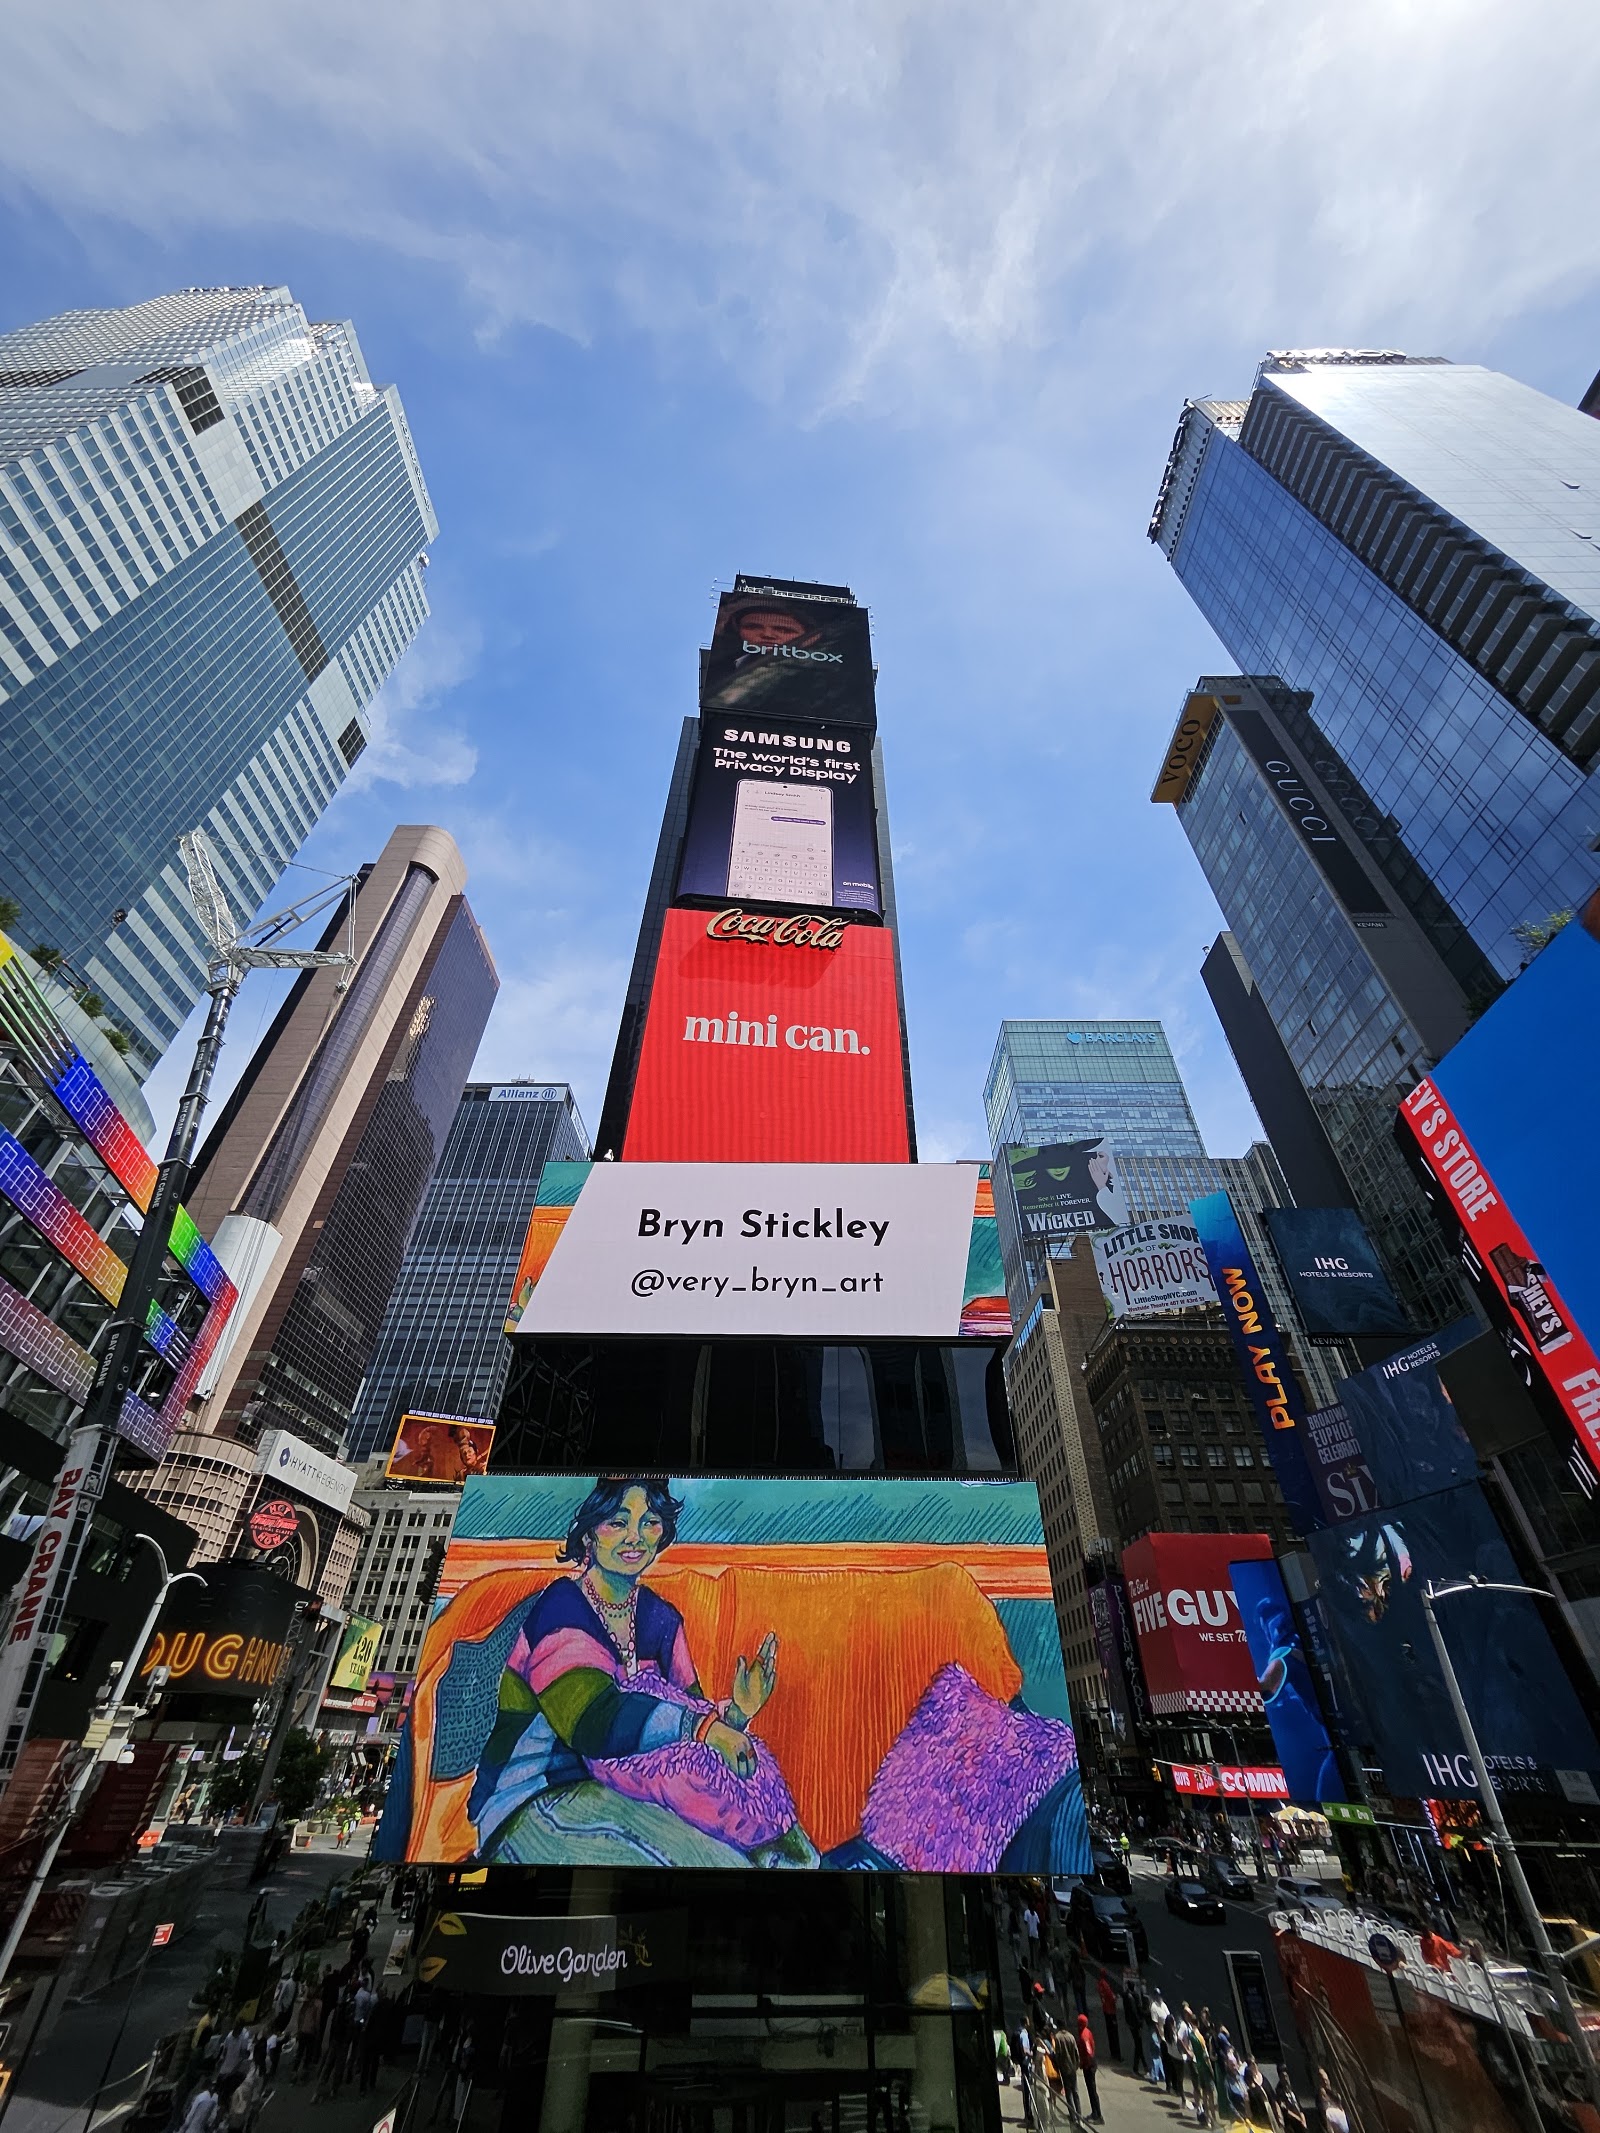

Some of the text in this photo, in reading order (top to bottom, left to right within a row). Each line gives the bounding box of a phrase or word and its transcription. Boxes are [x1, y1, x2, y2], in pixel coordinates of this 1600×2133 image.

[743, 640, 844, 664] britbox
[724, 729, 851, 753] SAMSUNG
[713, 748, 861, 771] The world's first
[715, 758, 857, 784] Privacy Display
[1265, 760, 1337, 841] GUCCI
[683, 1011, 871, 1056] mini can.
[1084, 1032, 1157, 1044] BARCLAYS
[498, 1089, 540, 1099] Allianz
[151, 1167, 170, 1209] BAY CRANE
[1433, 1129, 1498, 1222] STORE
[637, 1207, 891, 1247] Bryn Stickley
[1103, 1224, 1157, 1259] LITTLE
[1145, 1244, 1156, 1252] OF
[1299, 1271, 1331, 1279] HOTELS
[1337, 1271, 1374, 1279] RESORTS
[1314, 1257, 1349, 1270] IHG
[631, 1266, 884, 1298] @very_bryn_art
[1107, 1247, 1217, 1306] HORRORS
[1133, 1290, 1198, 1305] LittleShopNYC.com
[1222, 1268, 1295, 1429] PLAY NOW
[1312, 1337, 1346, 1345] KEVANI
[1406, 1345, 1433, 1360] HOTELS
[95, 1333, 120, 1388] BAY CRANE
[1382, 1357, 1410, 1380] IHG
[1410, 1350, 1441, 1369] RESORTS
[291, 1457, 349, 1495] HYATT REGENCY
[269, 1504, 291, 1515] HOT
[8, 1467, 83, 1647] BAY CRANE
[1132, 1591, 1168, 1636] FIVE
[353, 1635, 374, 1664] 120
[1198, 1632, 1216, 1642] WE
[1216, 1633, 1234, 1643] SET
[1422, 1753, 1479, 1788] IHG
[1482, 1755, 1538, 1771] OTELS &
[1173, 1771, 1191, 1787] GUYS
[1221, 1771, 1288, 1793] COMIN
[500, 1943, 628, 1983] Olive Garden
